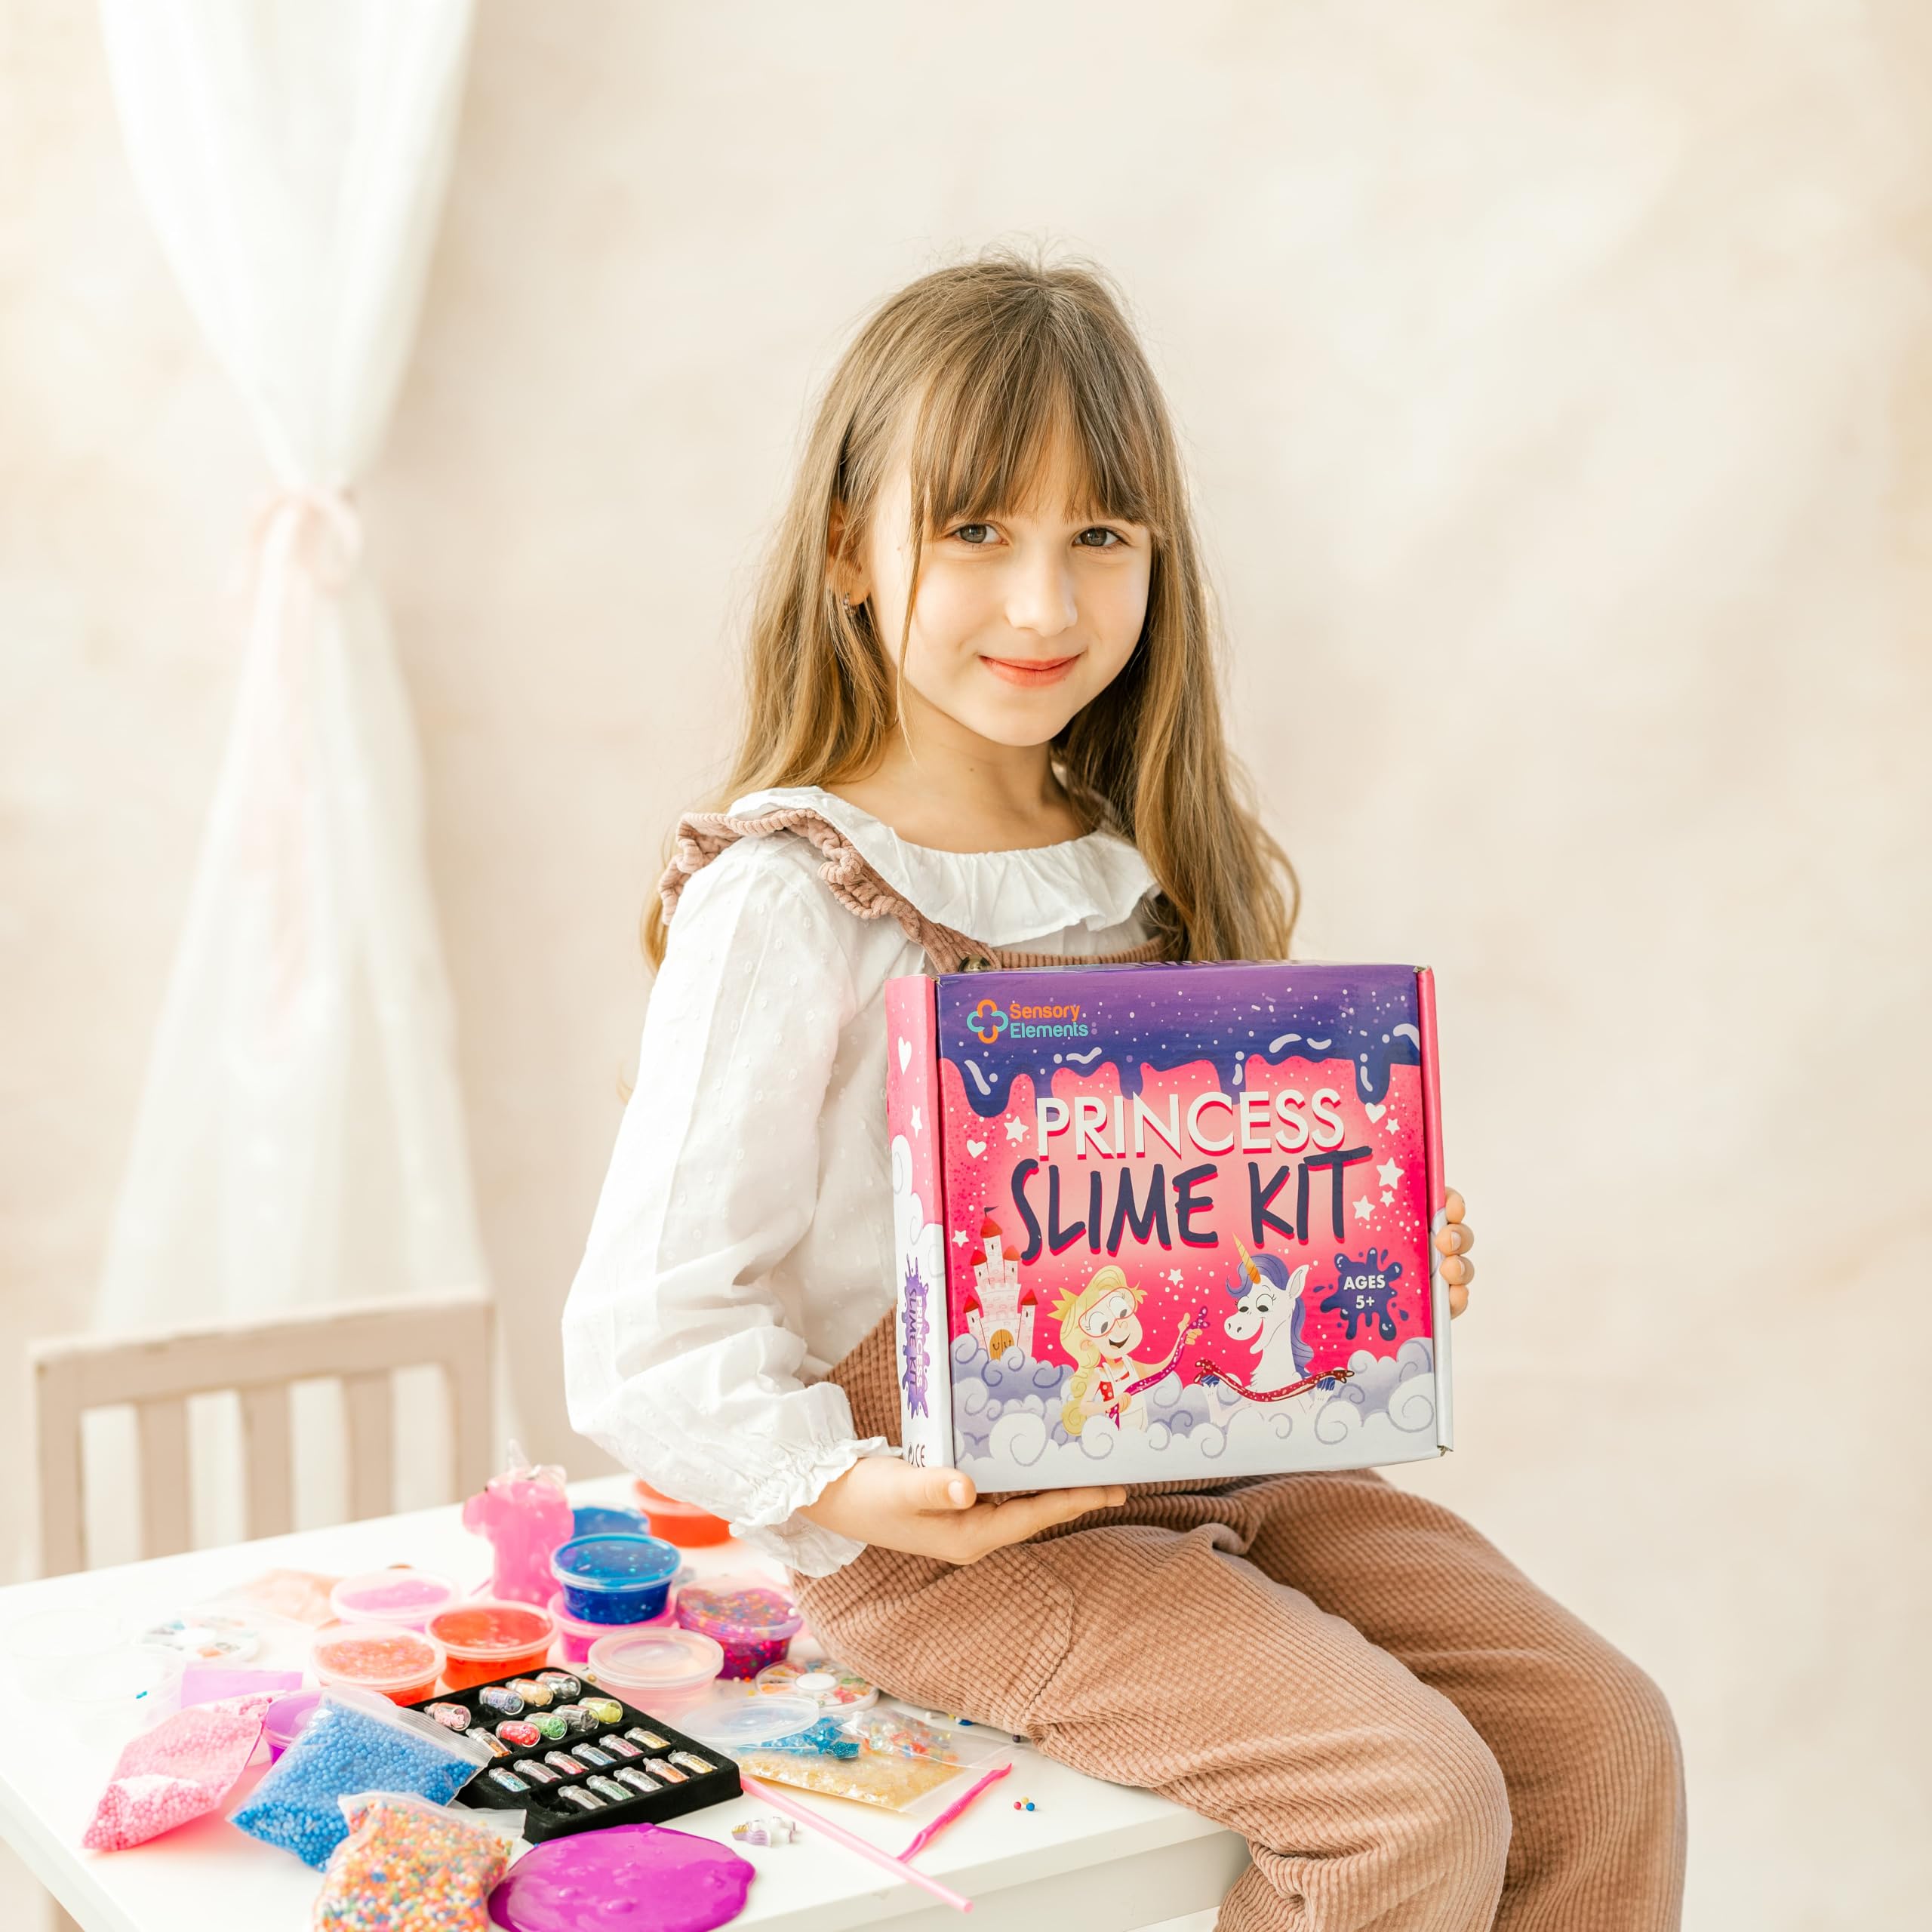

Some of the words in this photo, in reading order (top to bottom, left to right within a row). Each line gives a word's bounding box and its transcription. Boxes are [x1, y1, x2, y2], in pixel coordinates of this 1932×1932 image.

[1010, 1003, 1080, 1022] Sensory
[1010, 1022, 1088, 1038] Elements
[1036, 1088, 1346, 1161] PRINCESS
[1011, 1158, 1219, 1266] SLIME
[1247, 1146, 1373, 1249] KIT
[1343, 1274, 1386, 1291] AGES
[1355, 1294, 1375, 1309] 5+
[909, 1287, 917, 1347] SLIME
[915, 1295, 924, 1388] PRINCESS
[909, 1356, 918, 1395] KIT
